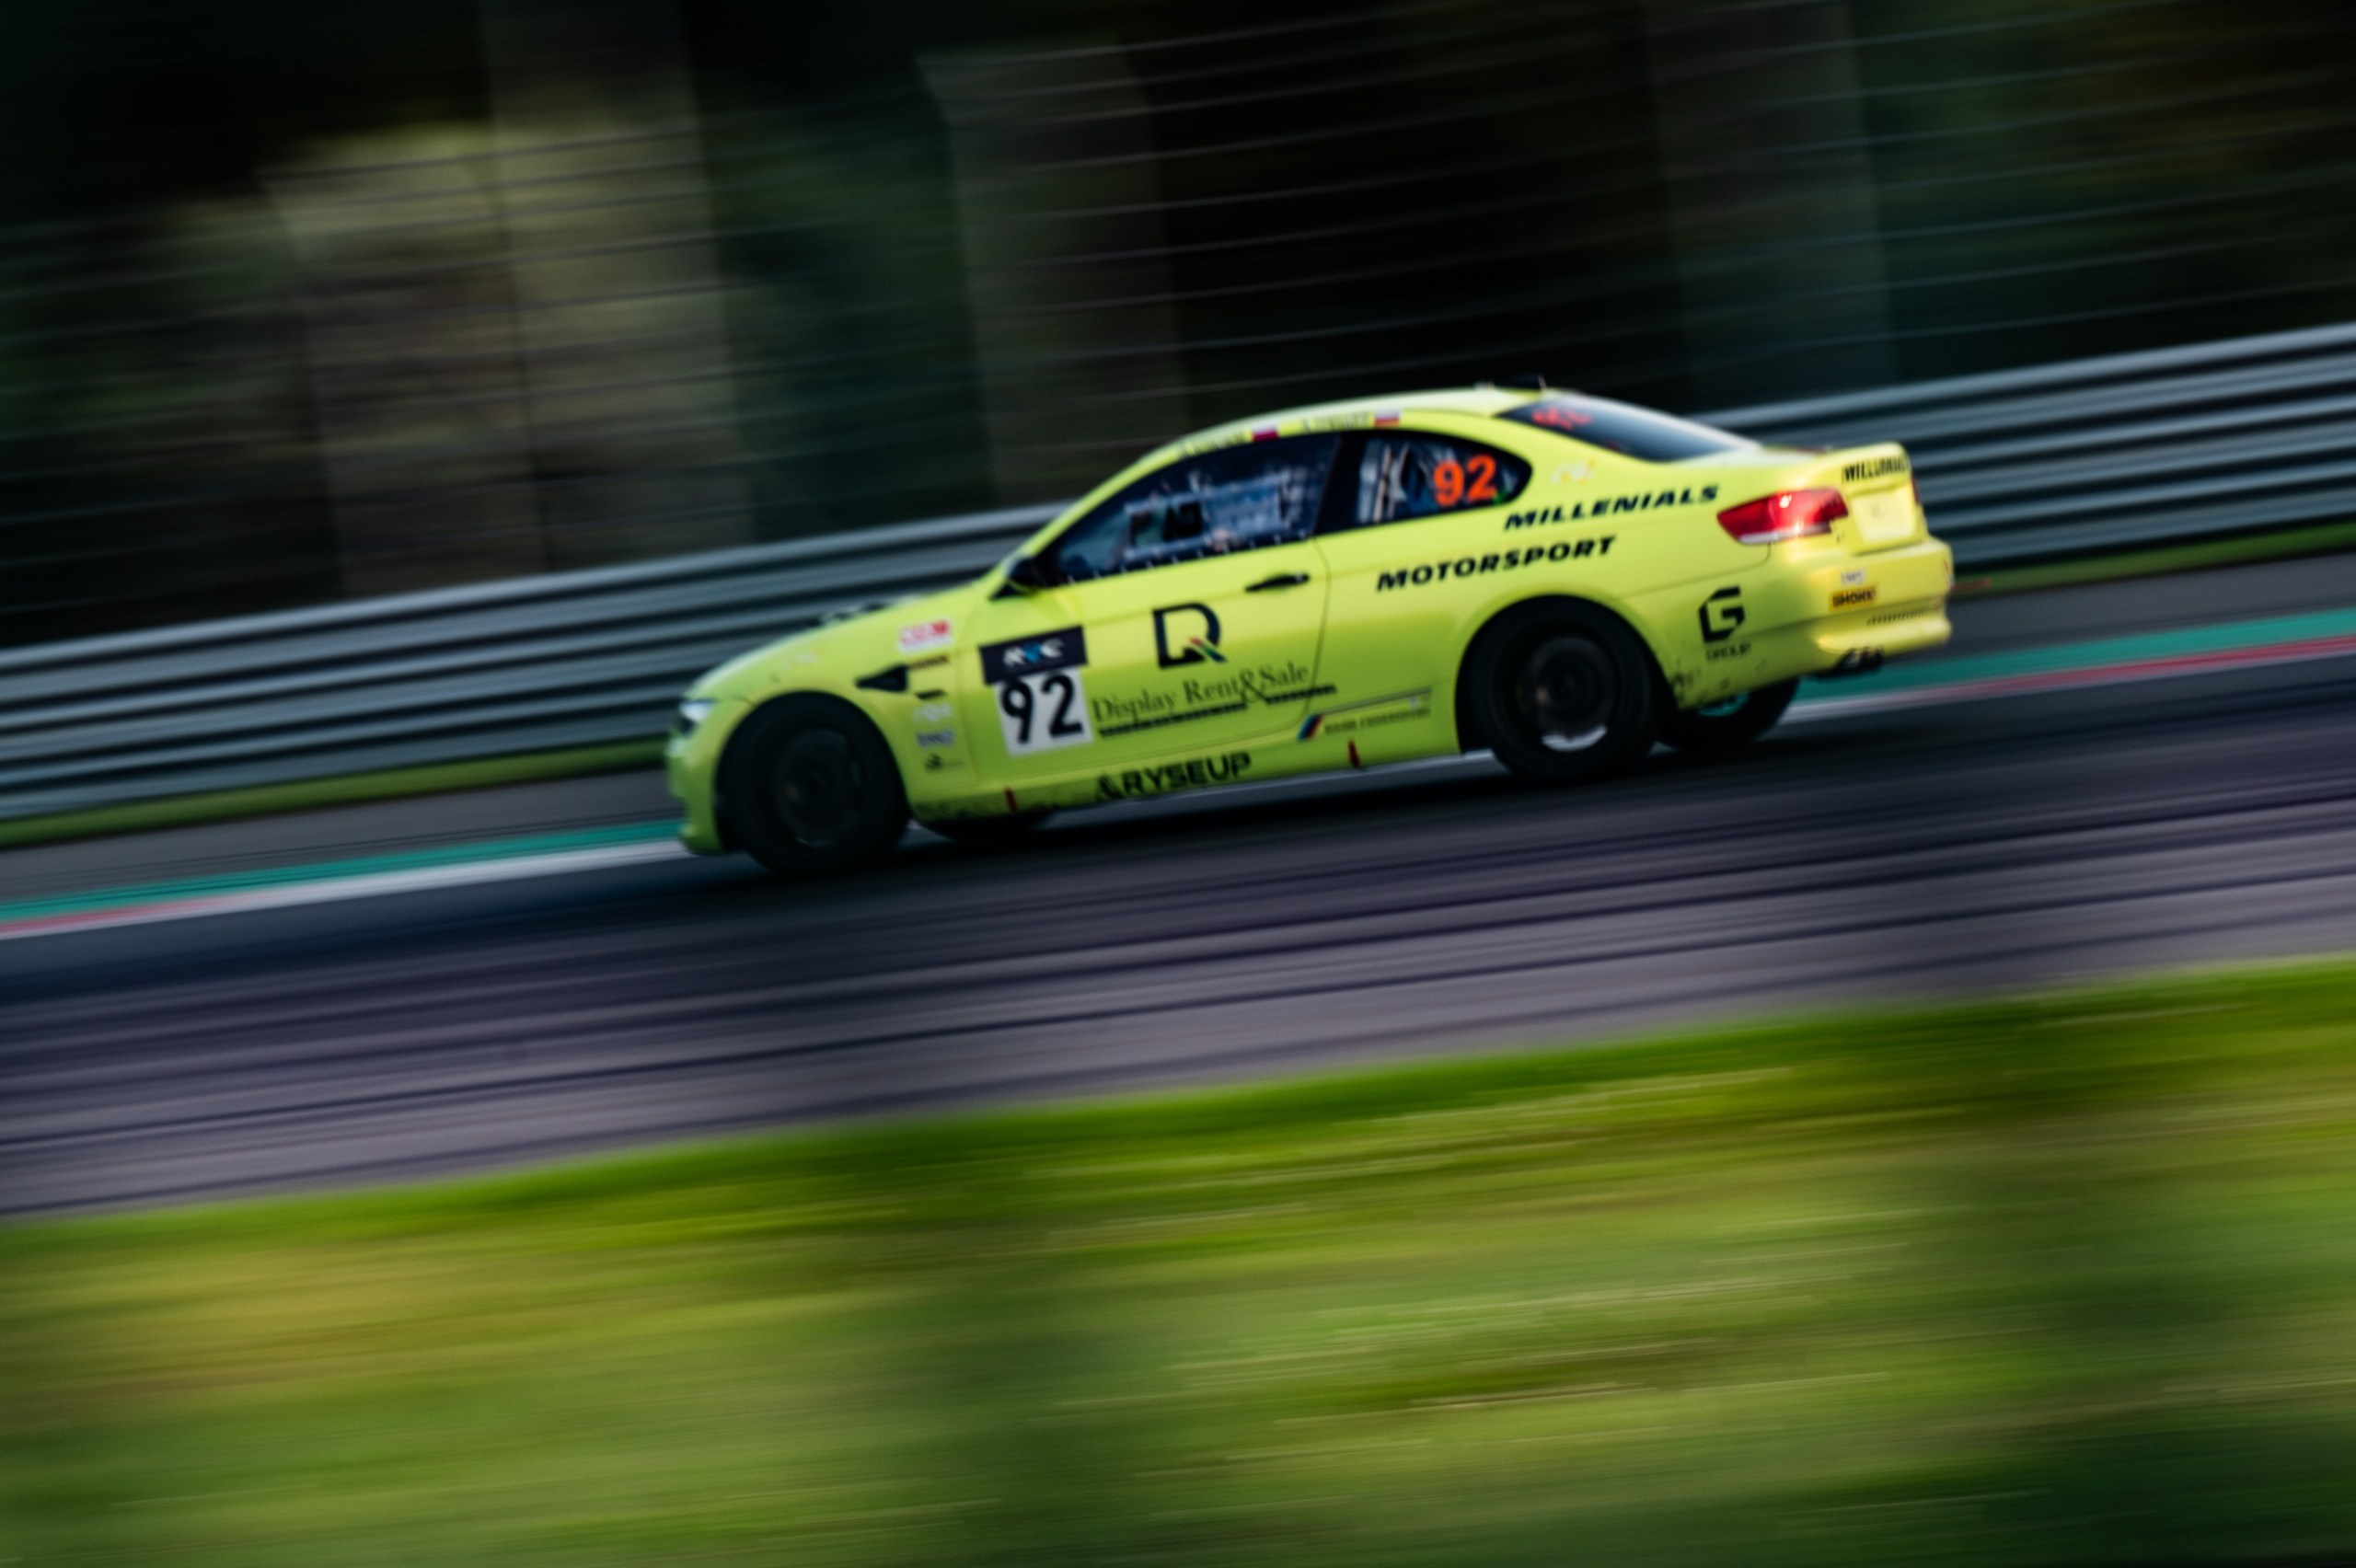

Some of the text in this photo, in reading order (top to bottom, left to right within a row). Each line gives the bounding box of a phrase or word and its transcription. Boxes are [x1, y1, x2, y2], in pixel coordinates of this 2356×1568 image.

[1433, 455, 1497, 507] 92
[1504, 485, 1719, 531] MILLENIALS
[1377, 536, 1616, 592] MOTORSPORT
[1000, 673, 1084, 744] 92
[1092, 688, 1175, 724] Display
